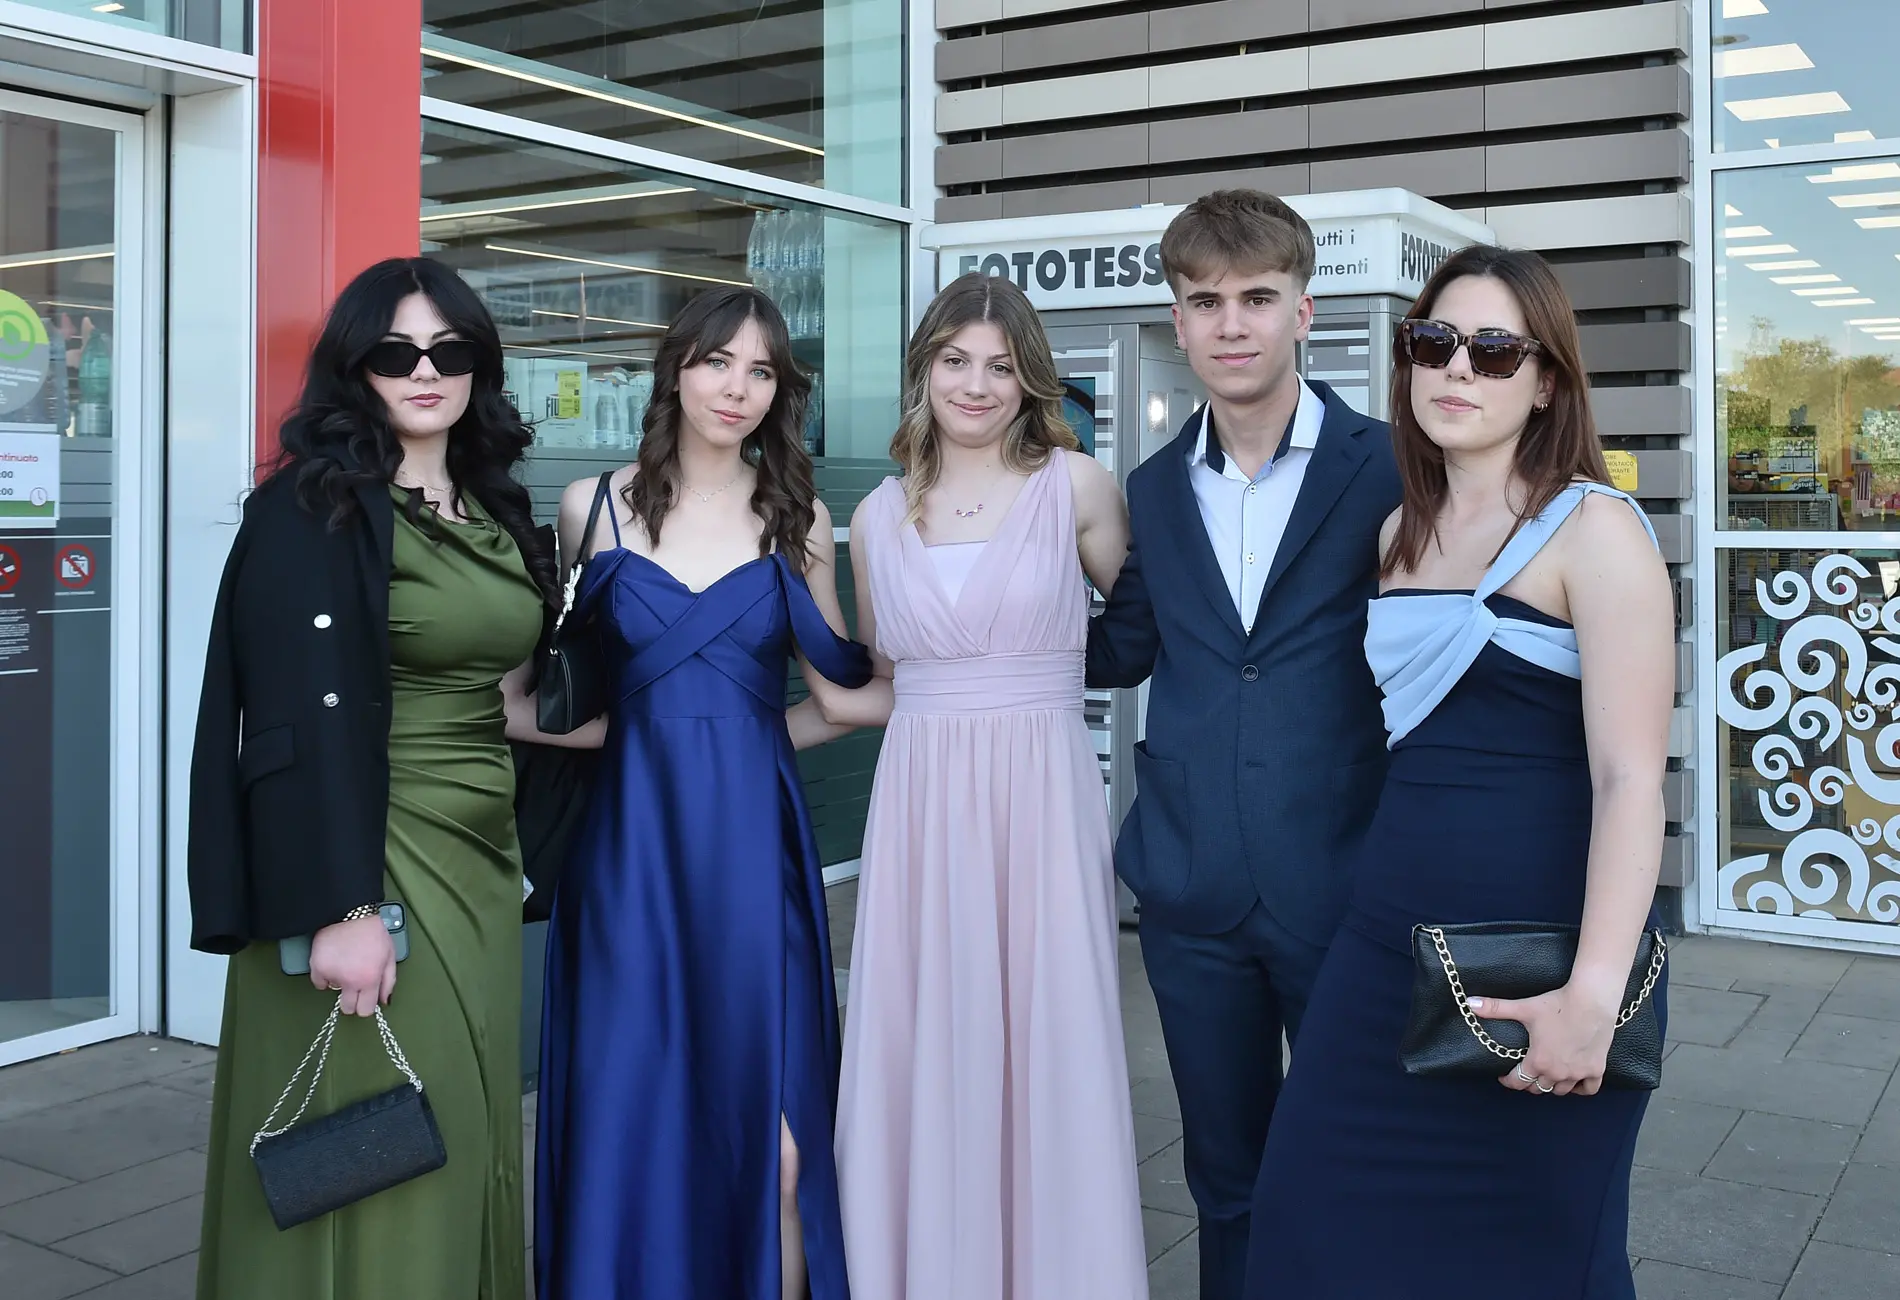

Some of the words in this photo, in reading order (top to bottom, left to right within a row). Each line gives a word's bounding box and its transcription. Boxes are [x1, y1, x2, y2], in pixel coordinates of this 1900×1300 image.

[1314, 230, 1343, 246] utti
[1350, 229, 1355, 245] i
[959, 243, 1165, 292] FOTOTESS
[0, 452, 39, 463] ntinuato
